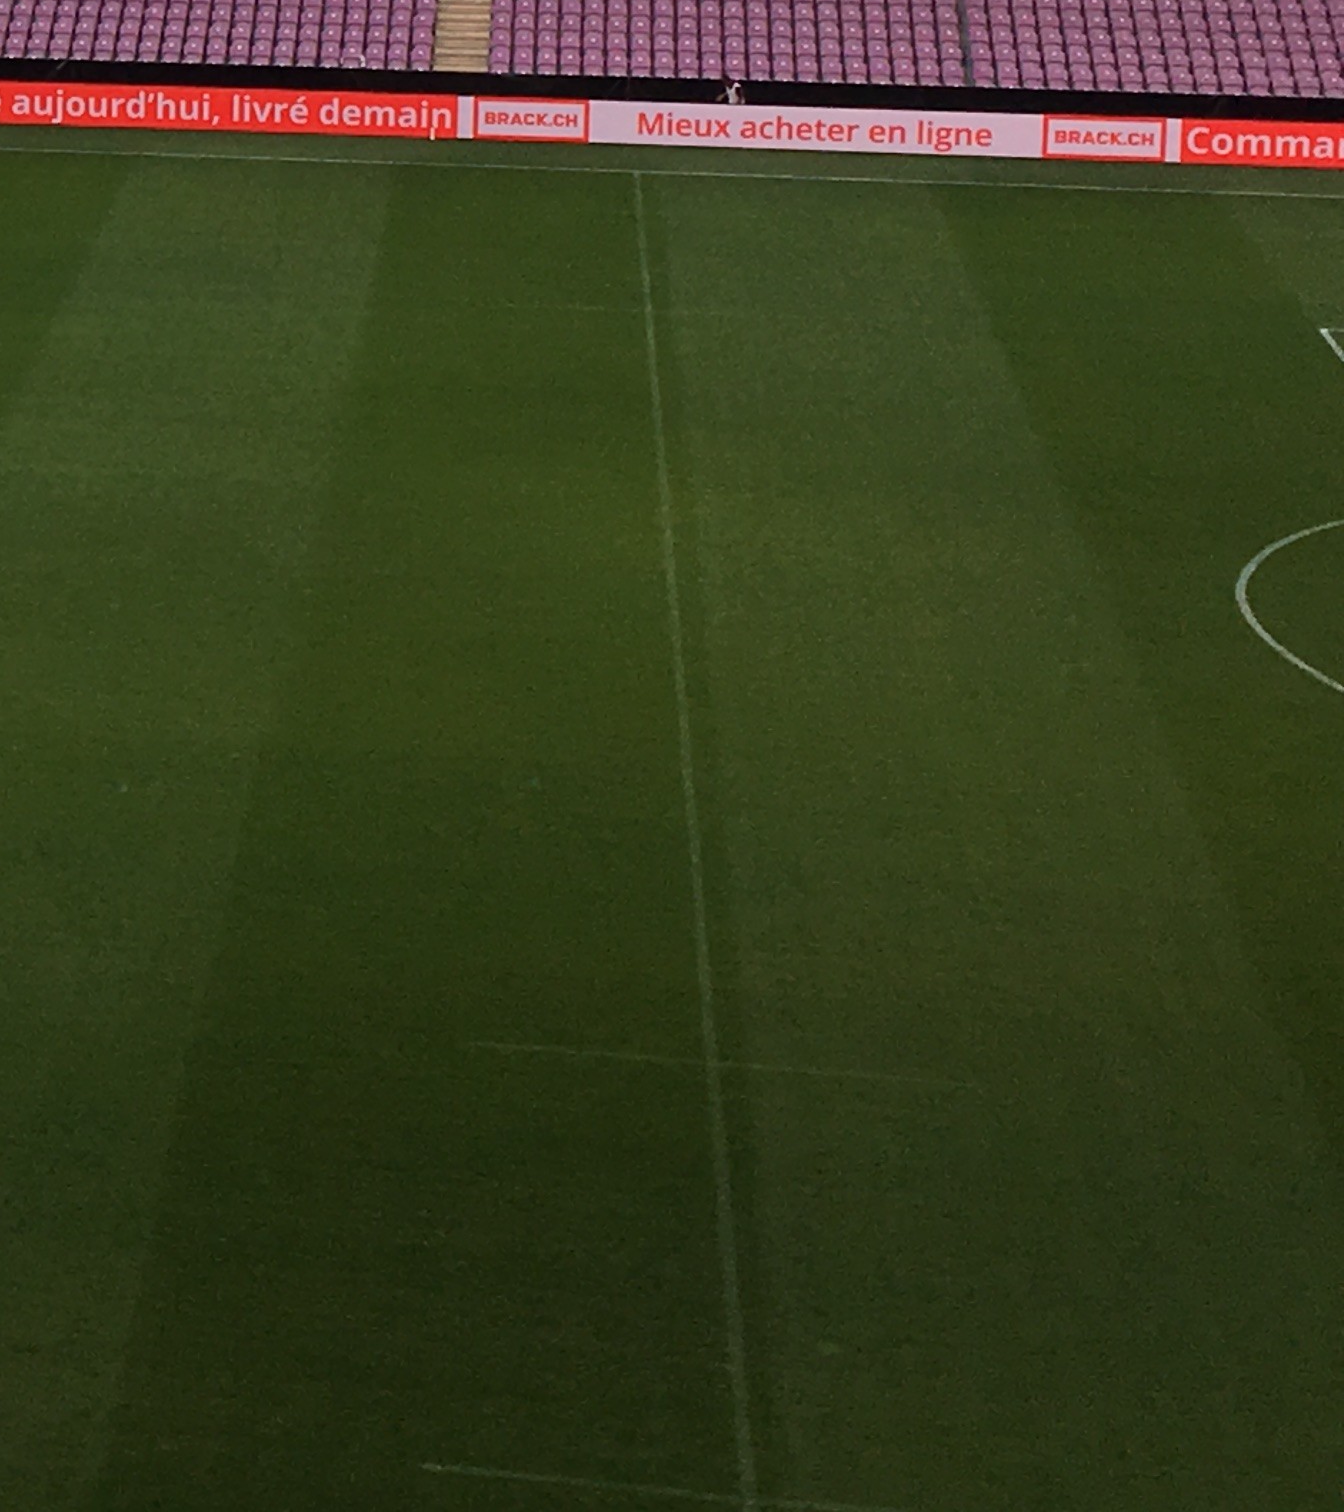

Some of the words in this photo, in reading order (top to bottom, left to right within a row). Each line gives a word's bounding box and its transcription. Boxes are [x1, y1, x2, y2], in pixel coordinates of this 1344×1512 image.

[12, 90, 220, 126] aujourd'hui,
[231, 94, 310, 125] livré
[319, 98, 453, 131] demain
[484, 111, 578, 128] BRACK.CH
[637, 111, 731, 138] Mieux
[740, 115, 857, 142] acheter
[868, 125, 906, 144] en
[917, 120, 993, 151] ligne
[1054, 129, 1155, 147] BRACK.CH
